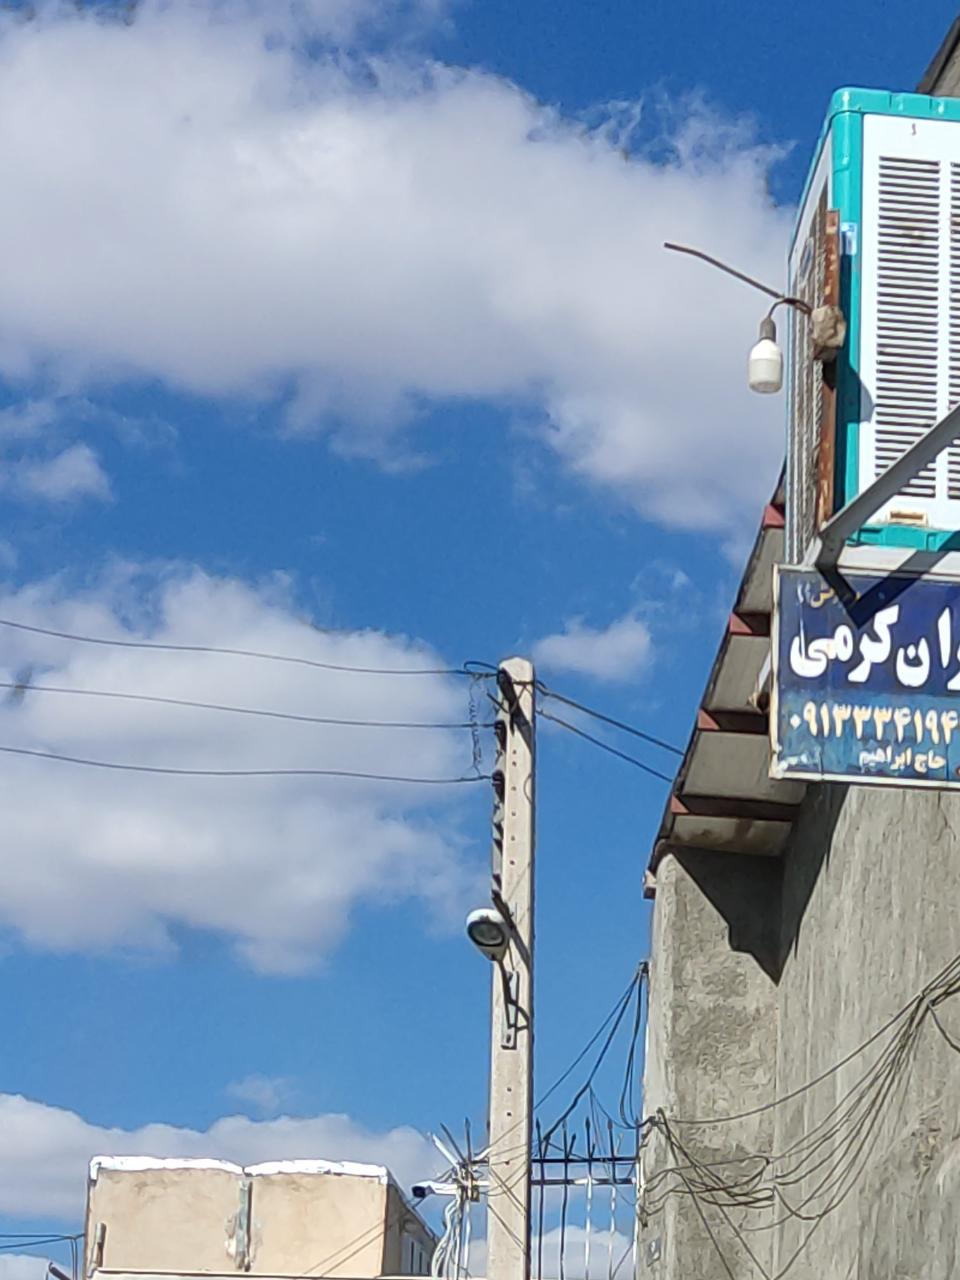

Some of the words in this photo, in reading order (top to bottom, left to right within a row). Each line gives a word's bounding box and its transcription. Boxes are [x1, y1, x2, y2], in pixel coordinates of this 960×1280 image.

[789, 603, 900, 684] کرمی
[858, 744, 913, 774] ابراهیم
[913, 748, 947, 774] حاج
